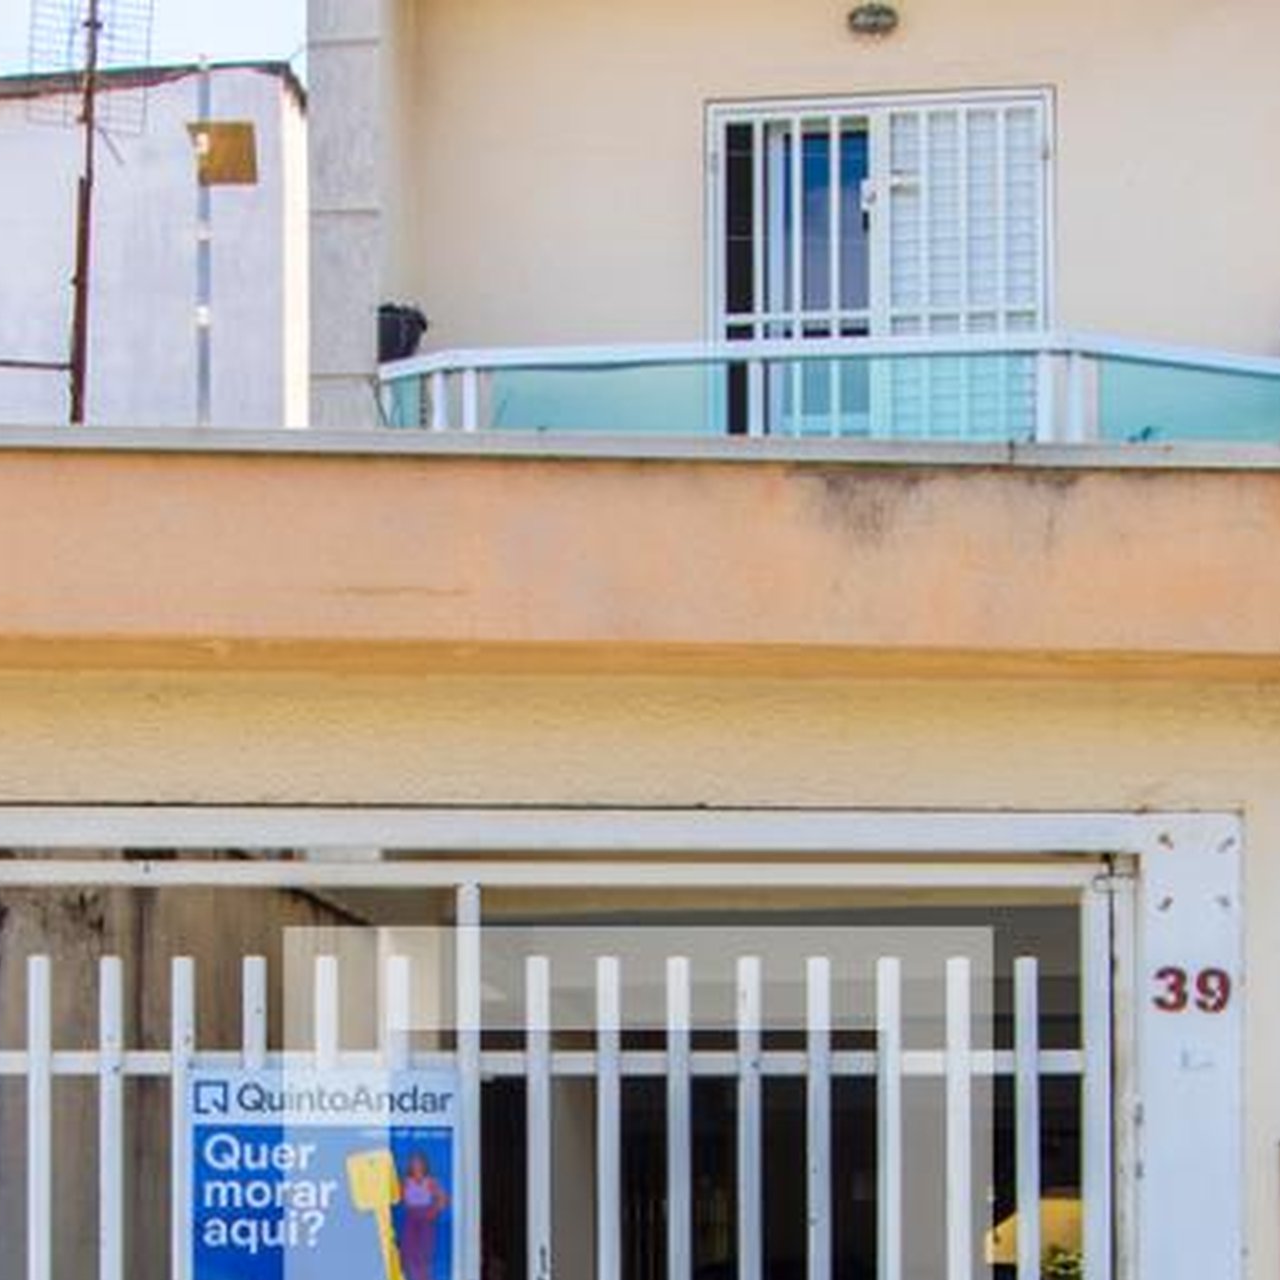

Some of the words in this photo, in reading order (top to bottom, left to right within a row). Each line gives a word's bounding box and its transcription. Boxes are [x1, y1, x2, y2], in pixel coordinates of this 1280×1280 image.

[1153, 967, 1231, 1013] 39
[236, 1081, 453, 1113] QuintoAndar
[204, 1133, 316, 1171] Quer
[204, 1177, 338, 1208] morar
[203, 1211, 324, 1252] aqui?
